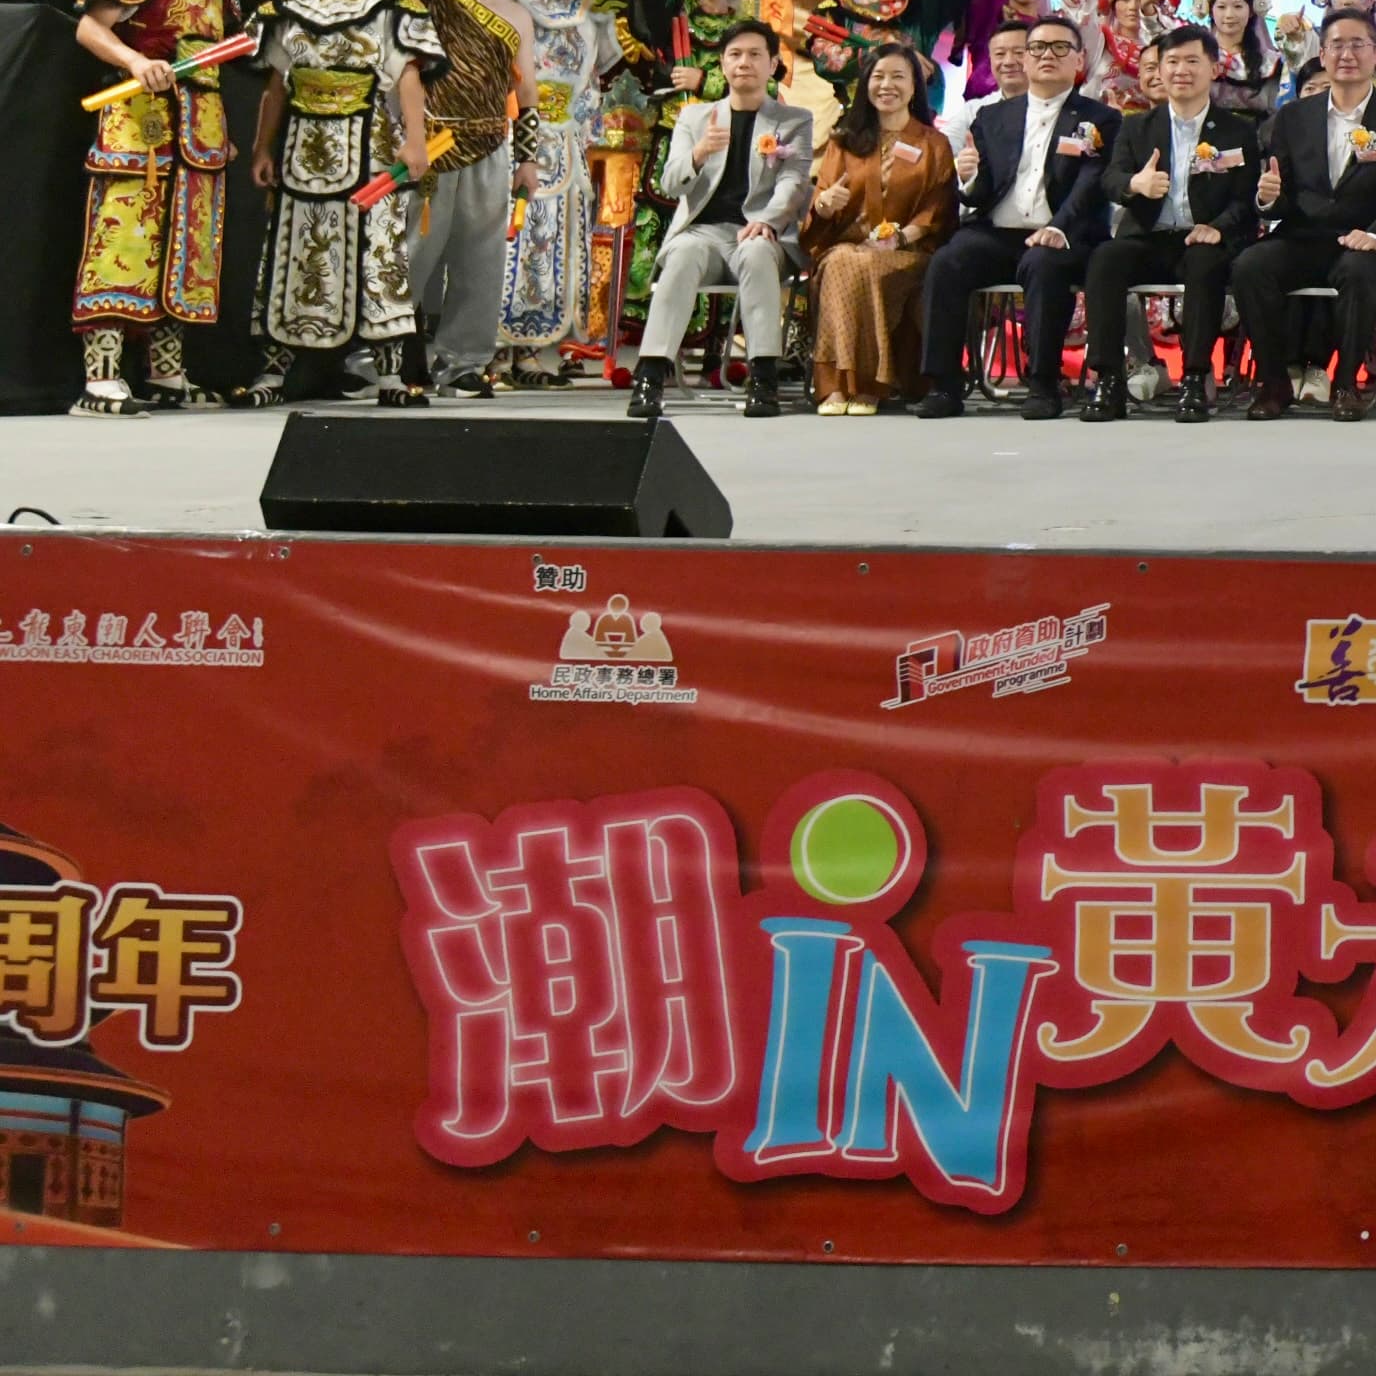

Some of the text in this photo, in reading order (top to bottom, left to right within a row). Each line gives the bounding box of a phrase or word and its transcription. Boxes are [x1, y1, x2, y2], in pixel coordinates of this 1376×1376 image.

[535, 566, 585, 591] 贊助
[0, 609, 252, 649] 龍東潮人聯會
[55, 648, 88, 660] EAST
[91, 649, 160, 662] CHAOREN
[164, 651, 263, 664] ASSOCIATION
[553, 667, 676, 686] 民政事務總署
[928, 651, 1056, 694] Government-funded
[996, 662, 1065, 692] programme
[531, 687, 696, 704] Home Affairs Department
[416, 814, 737, 1138] 潮
